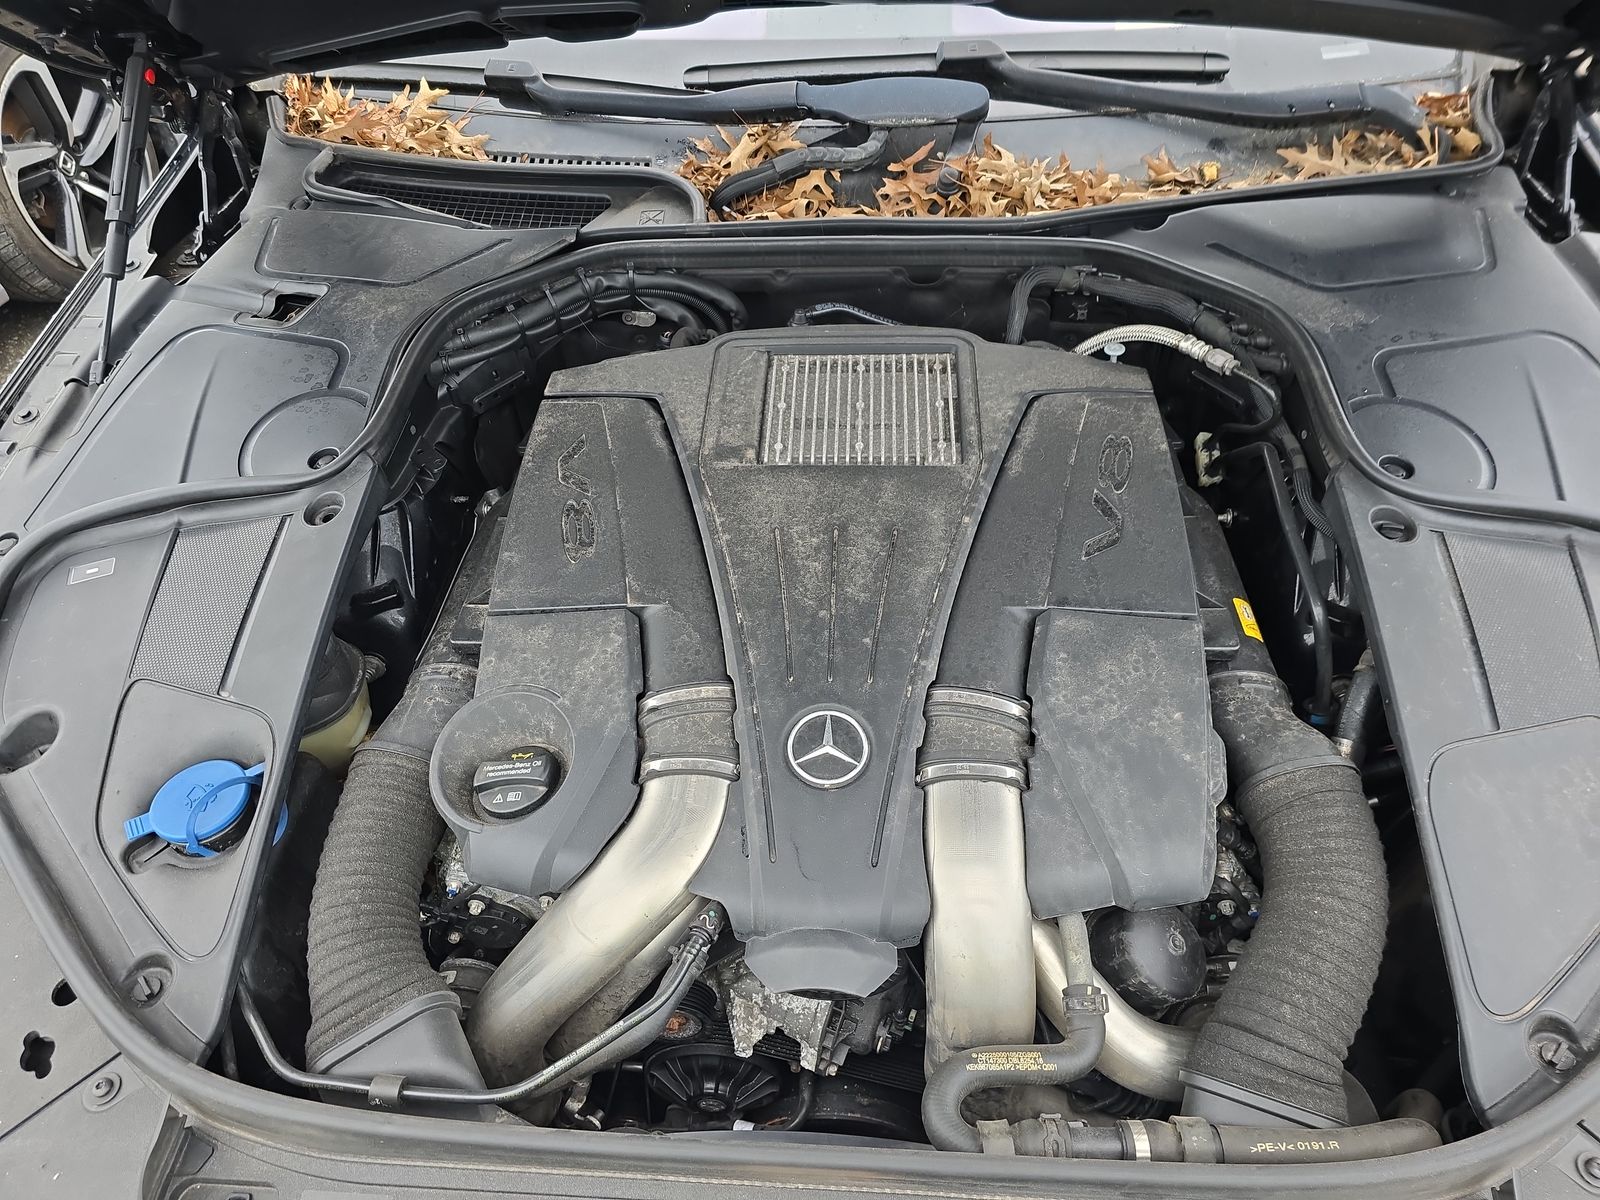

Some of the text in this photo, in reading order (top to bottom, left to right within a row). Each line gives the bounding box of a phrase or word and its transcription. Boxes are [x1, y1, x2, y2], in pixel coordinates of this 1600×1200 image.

[558, 433, 596, 563] V8
[1081, 434, 1133, 560] V8
[482, 762, 531, 771] Mercedes-Benz
[486, 767, 531, 777] recommended
[1249, 1140, 1340, 1153] >PE-V< 0191.R
